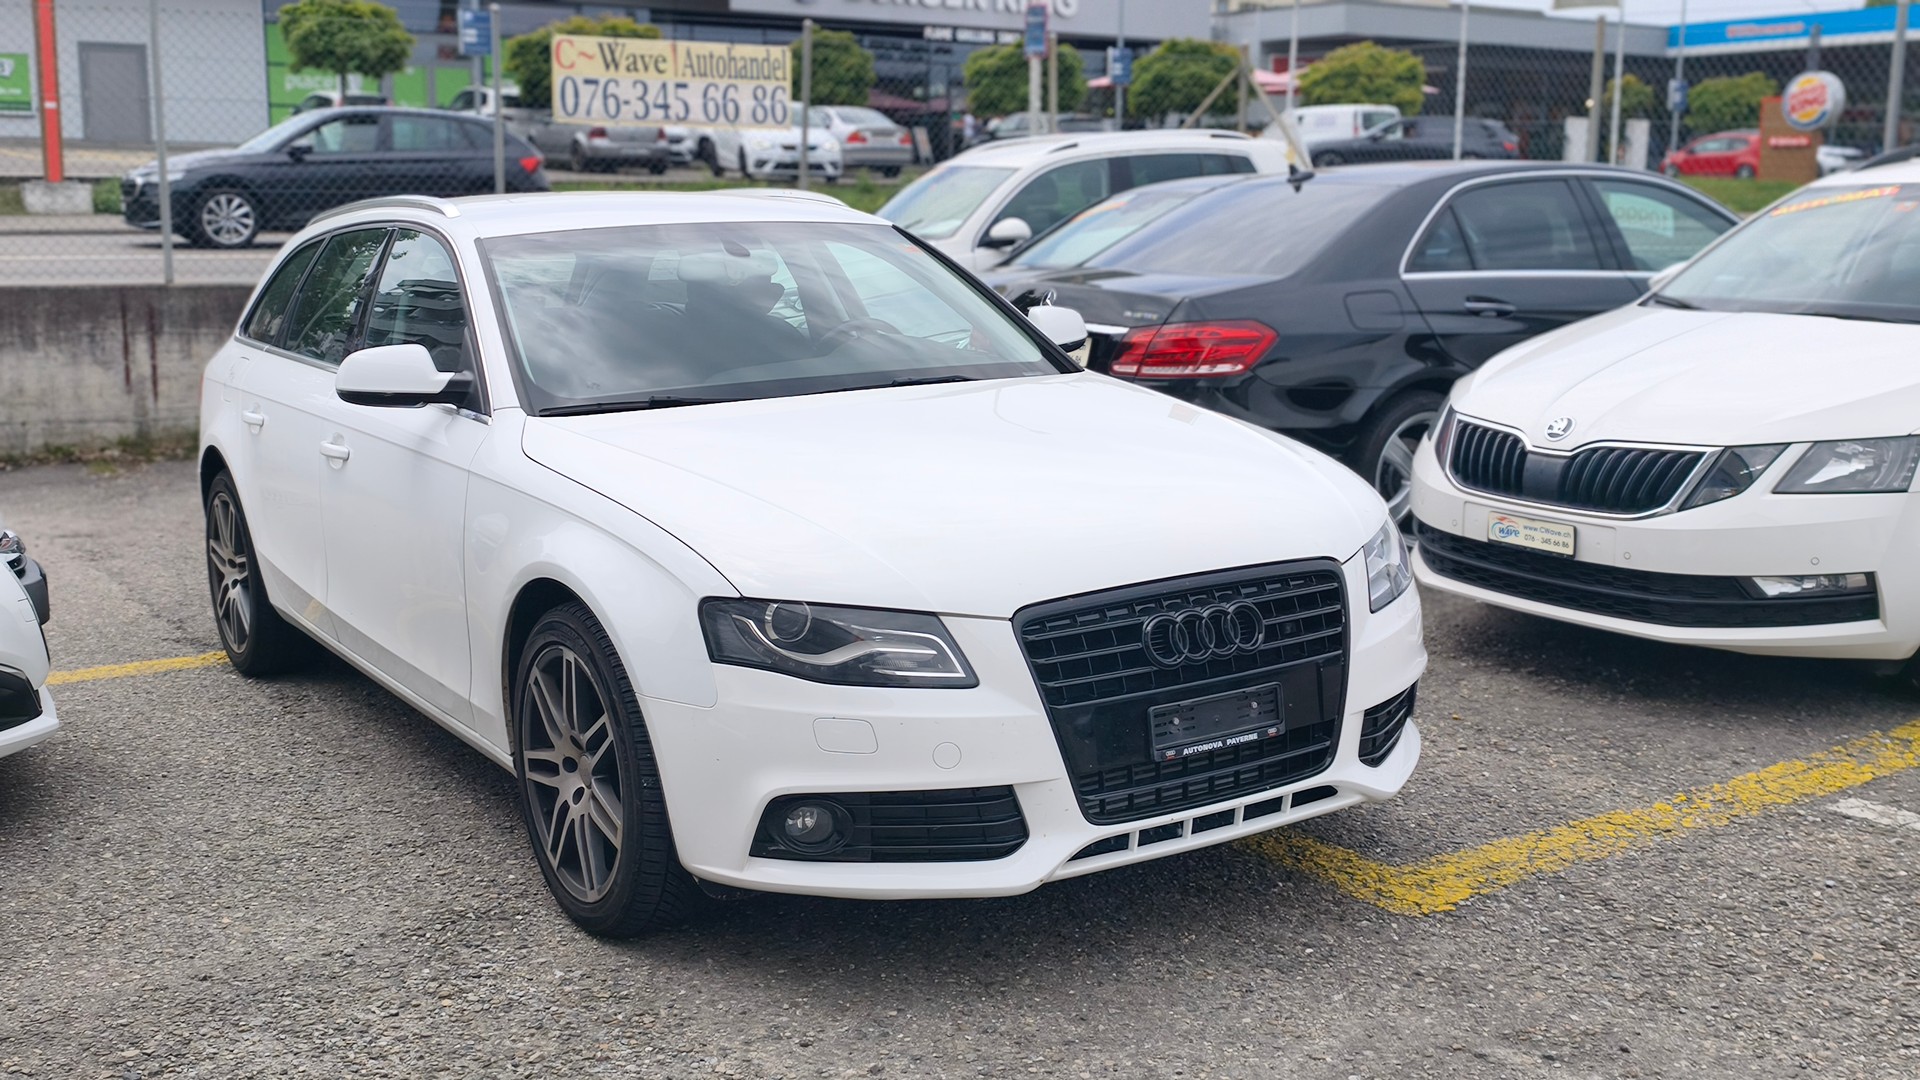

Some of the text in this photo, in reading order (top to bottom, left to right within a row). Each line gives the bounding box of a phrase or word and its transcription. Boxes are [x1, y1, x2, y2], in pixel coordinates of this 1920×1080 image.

[682, 46, 788, 82] Autohandel
[560, 75, 788, 125] 076-345 66 86
[1524, 534, 1536, 542] 076
[1540, 537, 1552, 545] 345
[1562, 541, 1570, 549] 86
[1183, 733, 1258, 755] AUTONOVA PAYERNE
